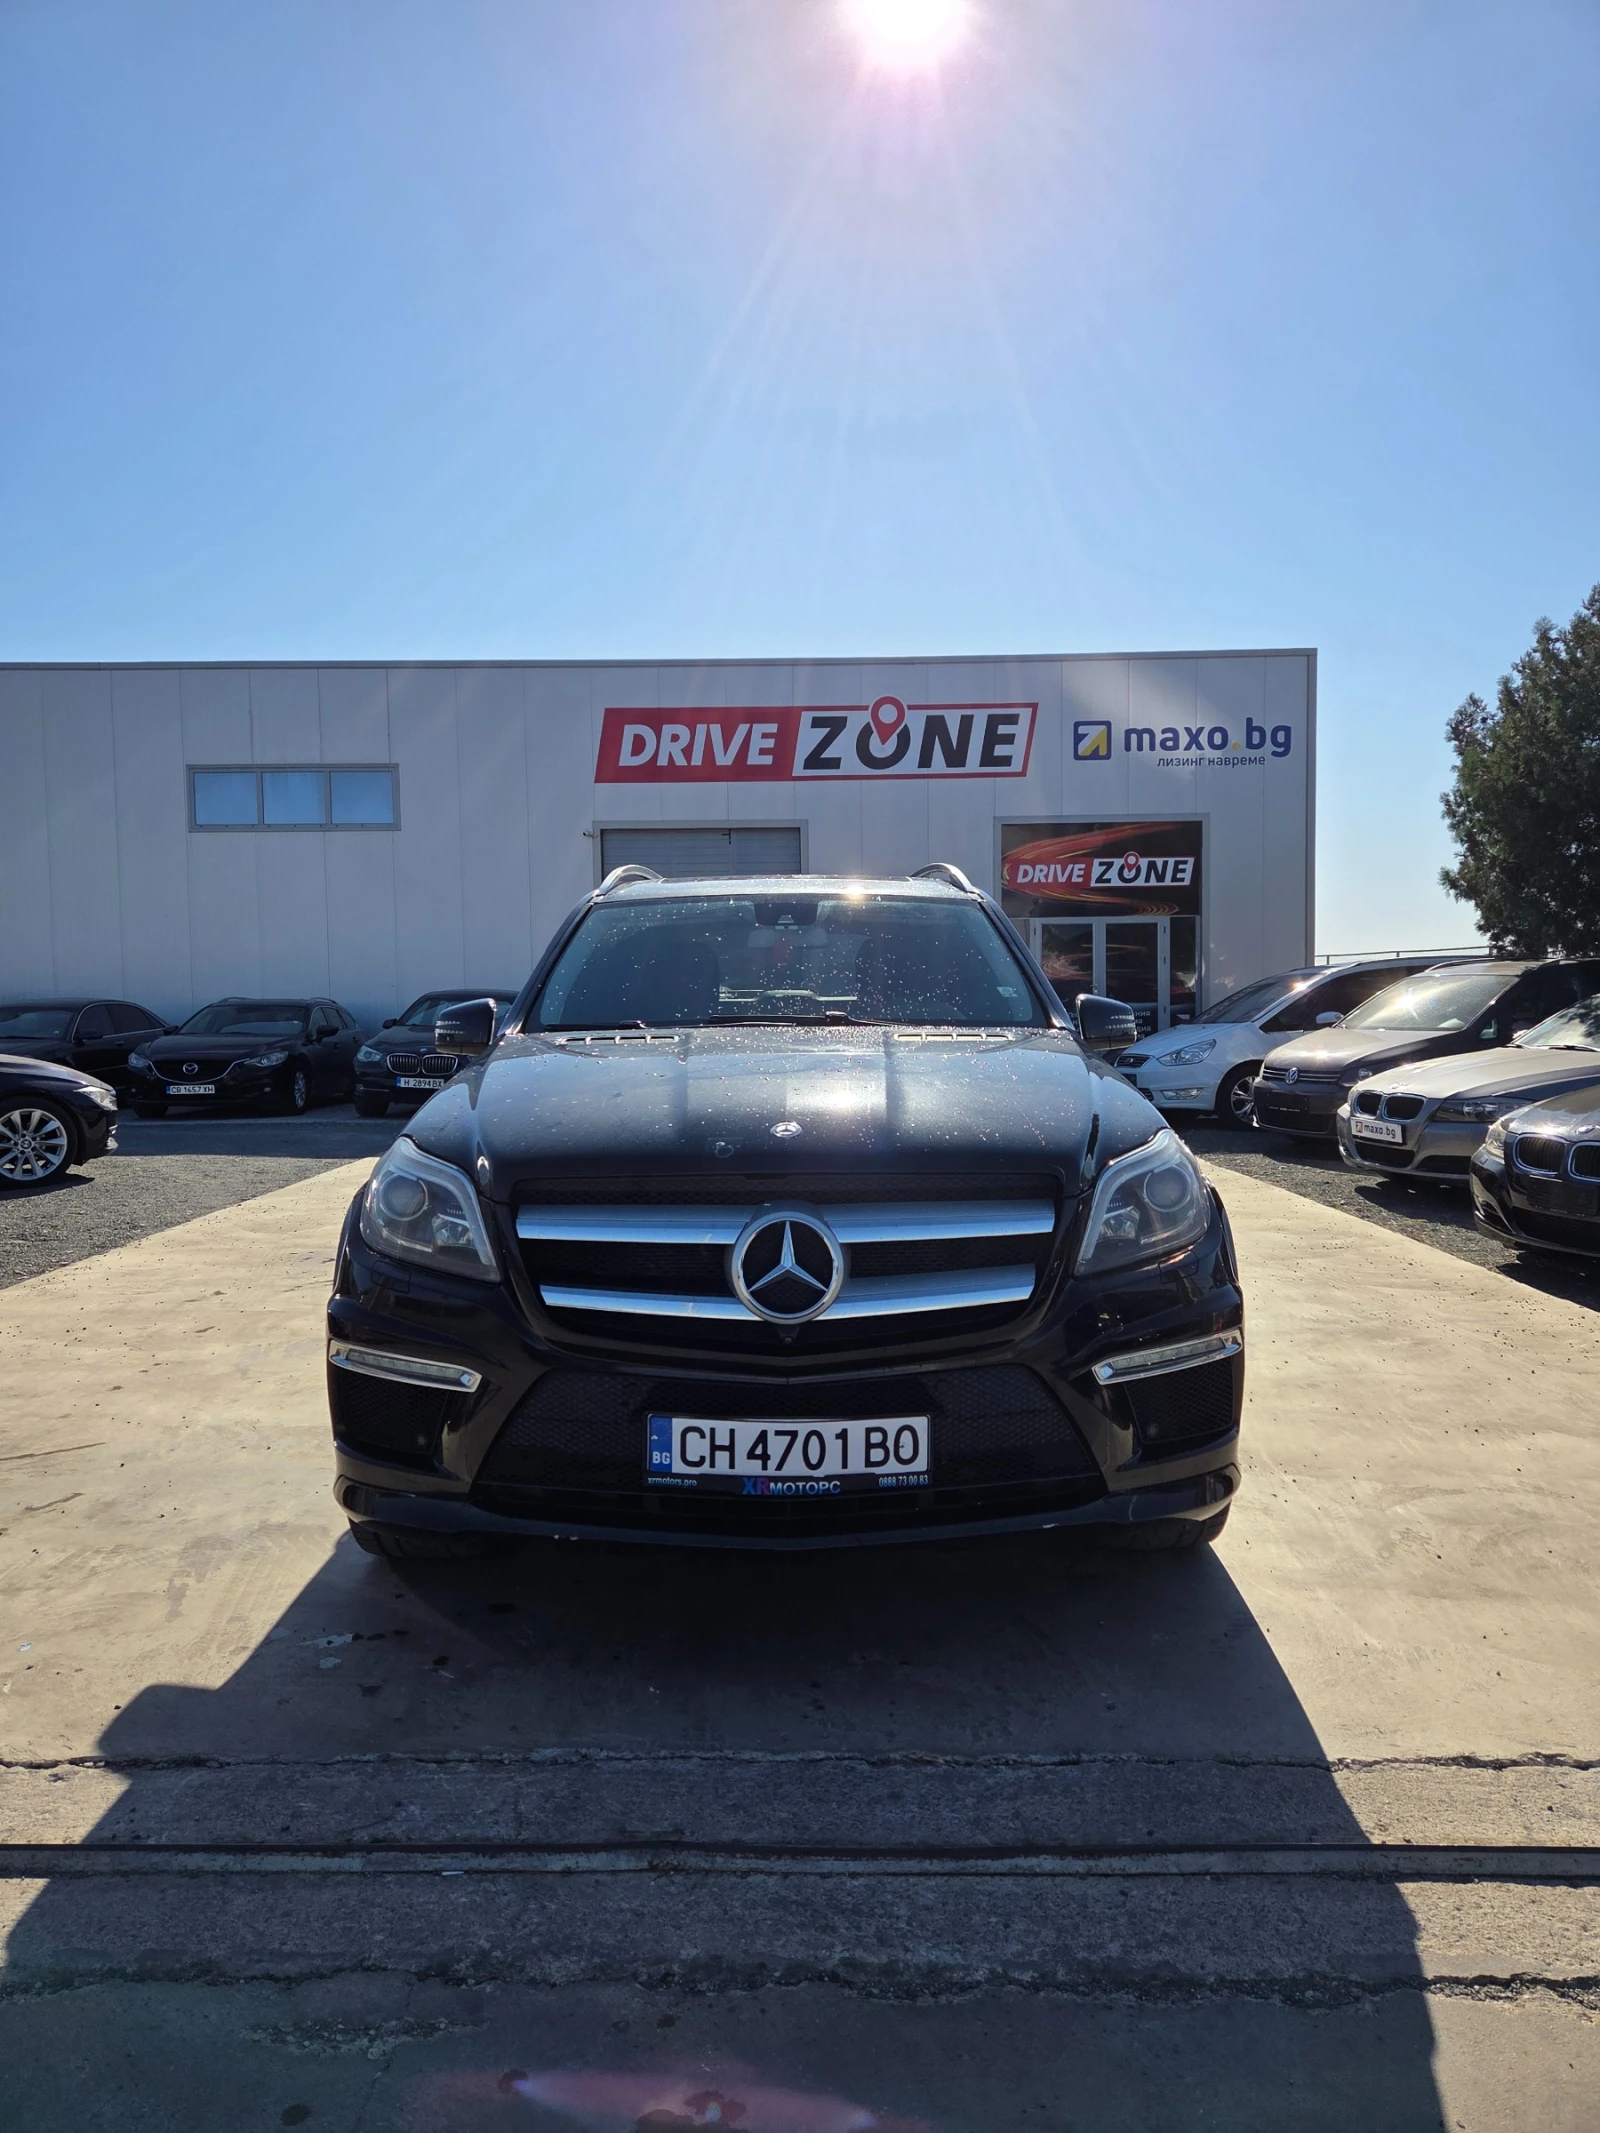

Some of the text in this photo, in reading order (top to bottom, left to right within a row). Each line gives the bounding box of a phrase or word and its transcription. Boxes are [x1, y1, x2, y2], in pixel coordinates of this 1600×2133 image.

[618, 712, 1020, 770] DRIVE ZONE
[1124, 717, 1292, 758] maxo.bg
[1157, 755, 1266, 768] лизинг навреме
[1016, 859, 1189, 884] DRIVE ZONE
[1364, 1124, 1396, 1139] maxo.bg
[652, 1451, 670, 1464] BG
[680, 1425, 736, 1470] CH
[746, 1427, 849, 1472] 4701
[647, 1477, 698, 1488] xrmotors.pro
